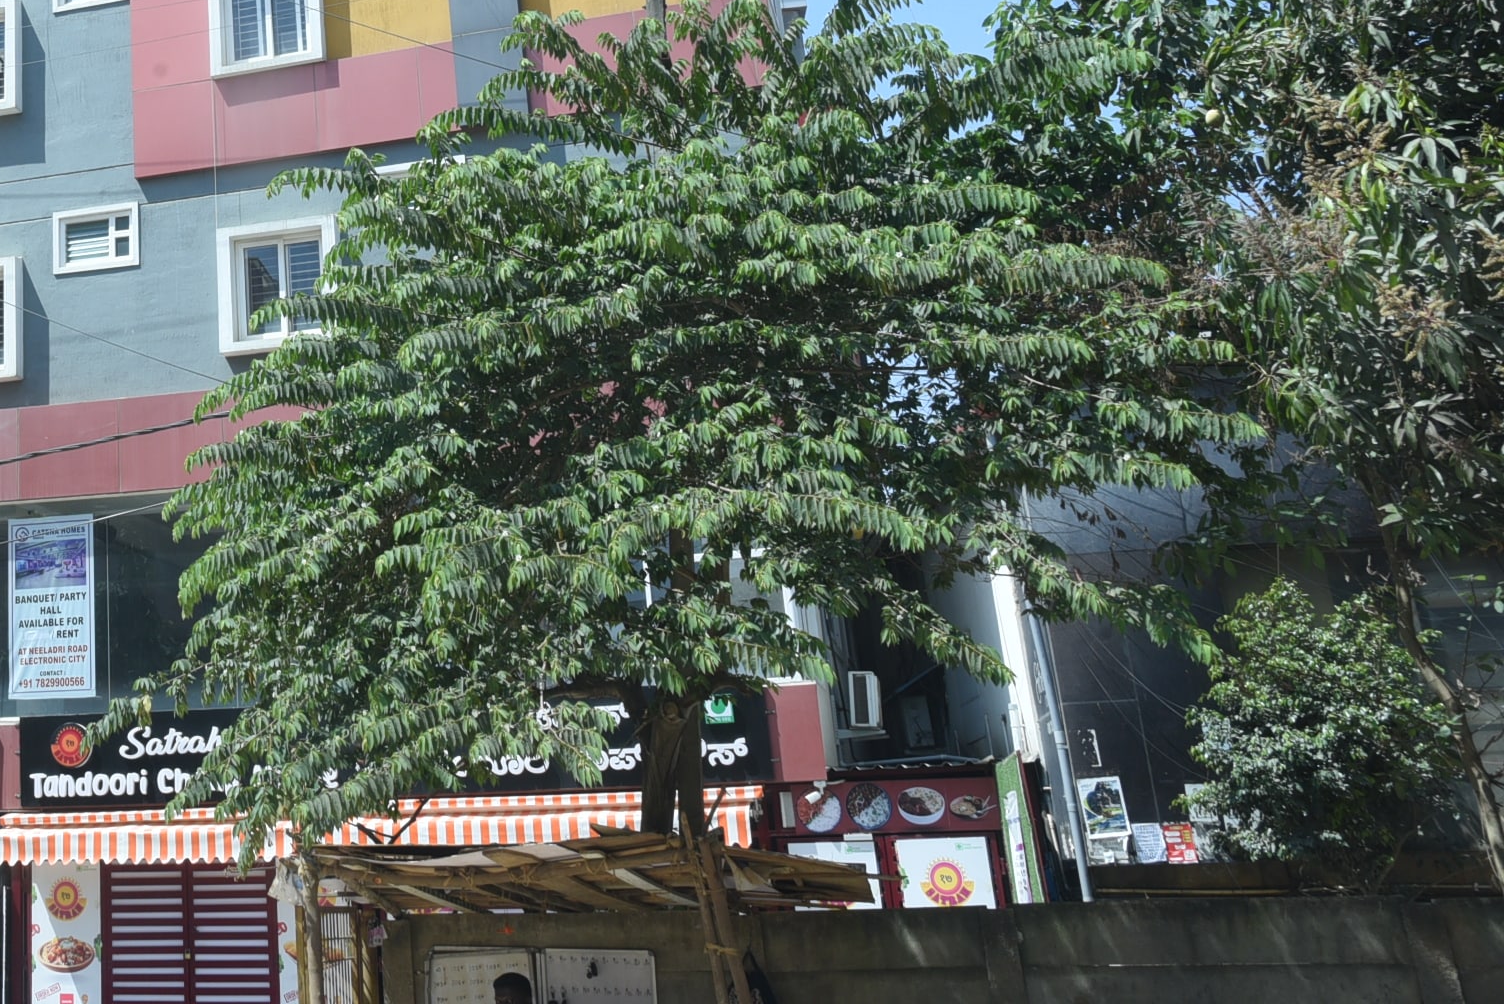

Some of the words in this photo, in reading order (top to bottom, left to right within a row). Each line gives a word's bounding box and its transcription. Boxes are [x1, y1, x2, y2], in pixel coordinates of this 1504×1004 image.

[60, 526, 85, 535] HOMES
[59, 592, 87, 602] PARTY
[40, 606, 62, 615] HALL
[18, 618, 64, 628] AVAILABLE
[67, 616, 84, 625] FOR
[56, 629, 79, 639] RENT
[18, 648, 27, 656] AT
[29, 645, 65, 655] NEELADRI
[67, 644, 88, 653] ROAD
[20, 655, 66, 665] ELECTRONIC
[68, 655, 86, 663] CITY
[18, 679, 32, 688] +91
[36, 677, 85, 688] 7829900566
[29, 768, 148, 799] Tandoori
